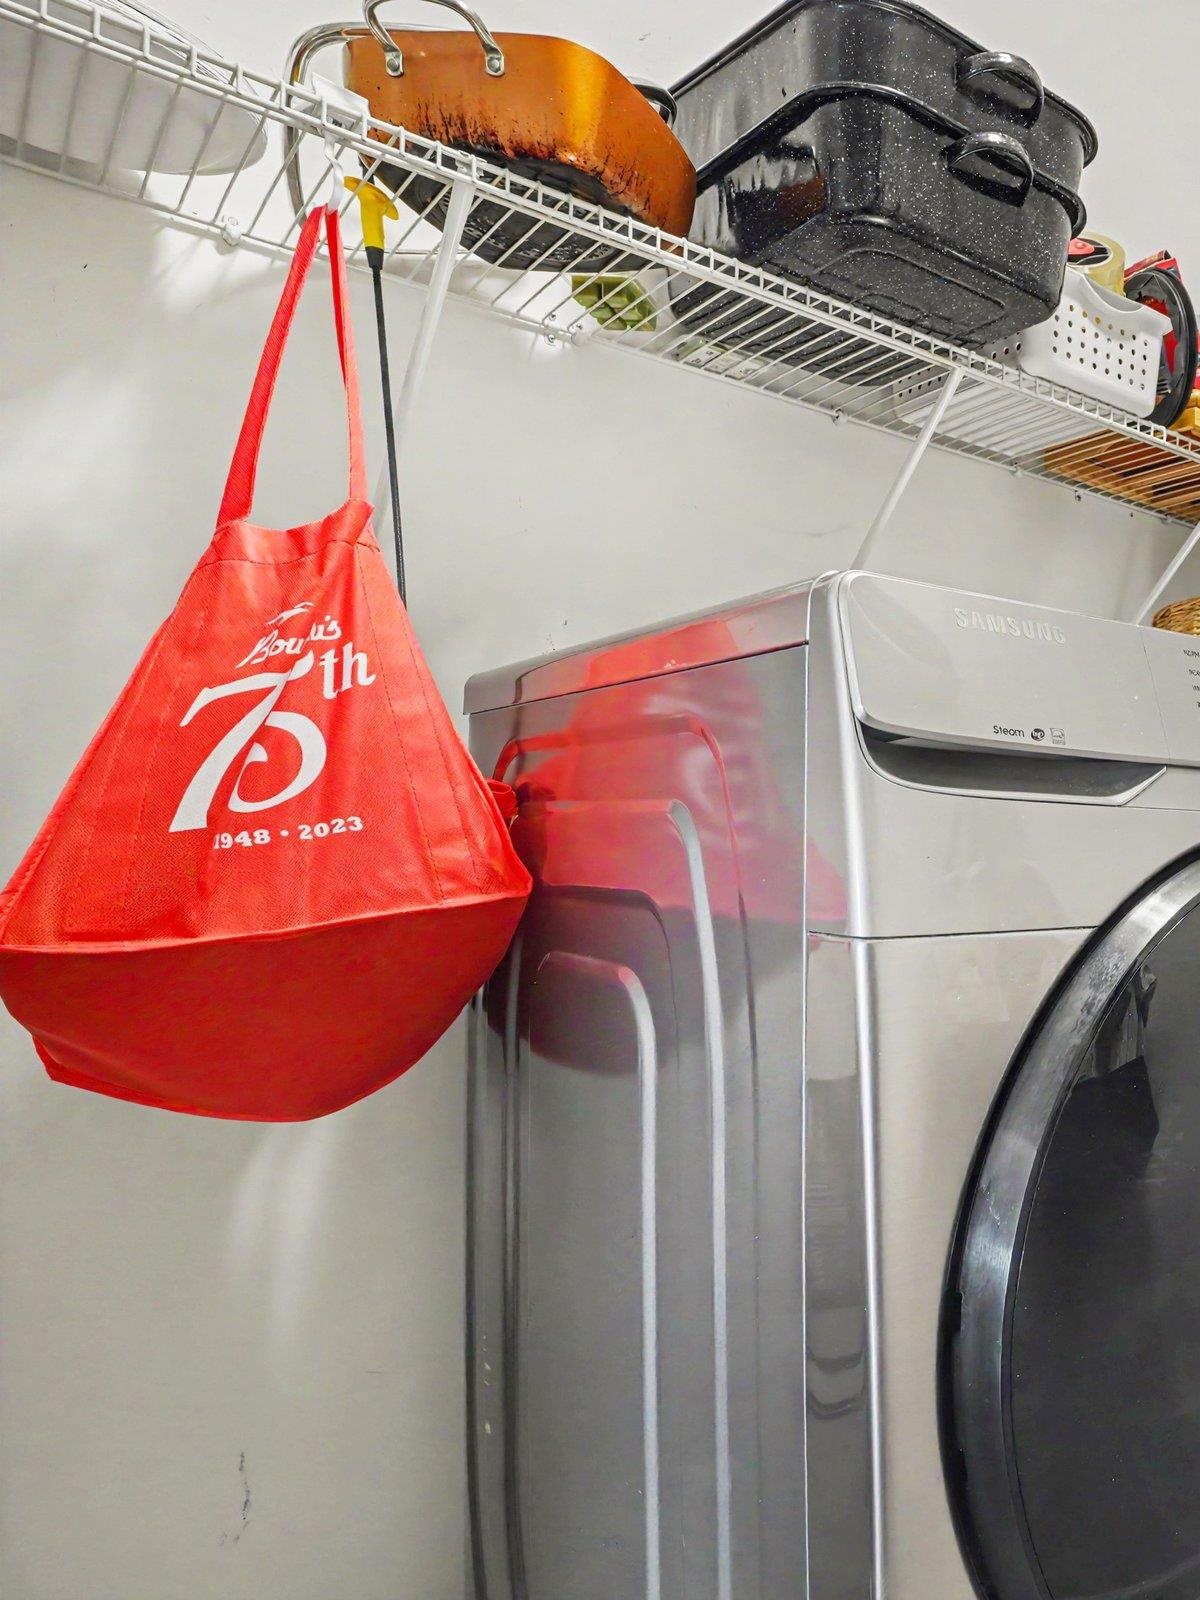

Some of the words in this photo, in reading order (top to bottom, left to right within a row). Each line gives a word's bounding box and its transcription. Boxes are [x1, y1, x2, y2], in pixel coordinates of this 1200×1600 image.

[954, 607, 1067, 645] SAMSUNG
[993, 725, 1025, 738] Steam
[213, 829, 271, 849] 1948
[298, 816, 364, 840] 2023
